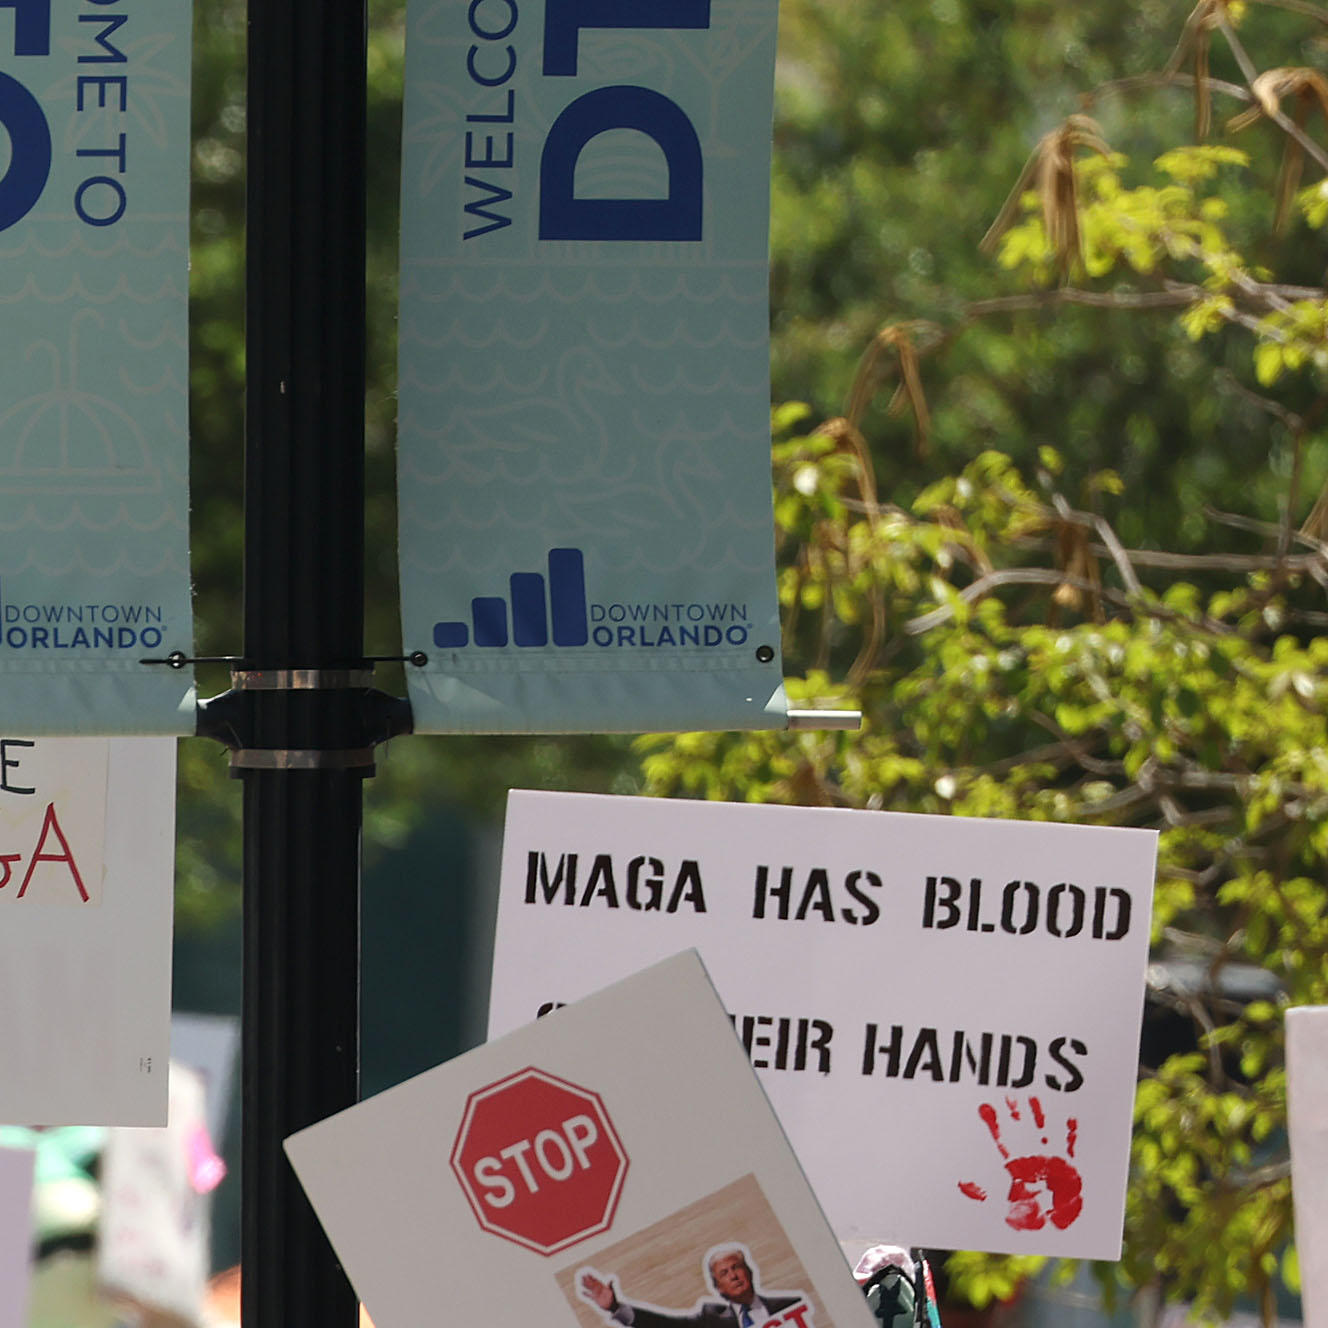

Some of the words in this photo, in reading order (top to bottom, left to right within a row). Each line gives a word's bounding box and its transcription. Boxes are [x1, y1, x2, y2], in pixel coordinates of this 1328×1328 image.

[74, 133, 127, 227] TO
[5, 604, 161, 623] DOWNTOWN
[5, 625, 162, 649] ORLANDO
[590, 604, 746, 623] DOWNTOWN
[591, 625, 748, 649] ORLANDO
[523, 850, 708, 916] MAGA
[752, 864, 882, 928] HAS
[923, 876, 1132, 943] BLOOD
[727, 1014, 832, 1076] EIR
[862, 1022, 1090, 1094] HANDS
[474, 1114, 600, 1211] STOP
